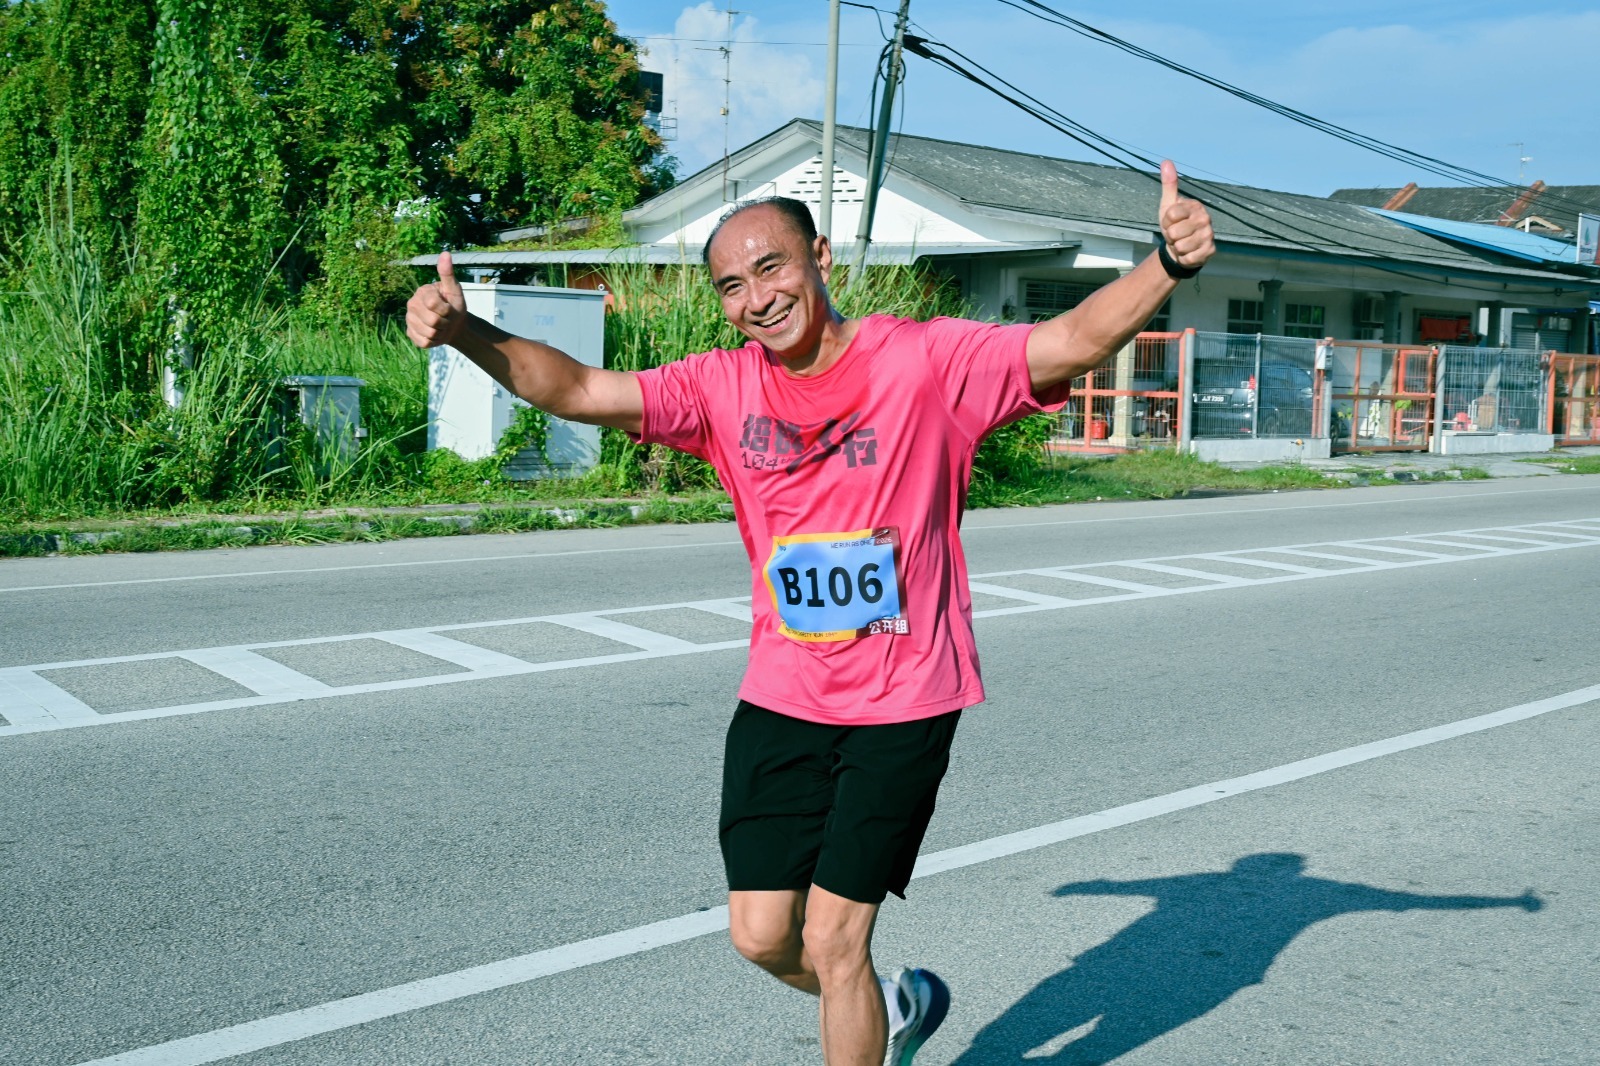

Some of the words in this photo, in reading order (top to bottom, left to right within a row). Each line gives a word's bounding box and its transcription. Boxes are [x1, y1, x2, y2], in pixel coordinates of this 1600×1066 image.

[777, 562, 884, 608] B106
[868, 619, 908, 635] 公开组
